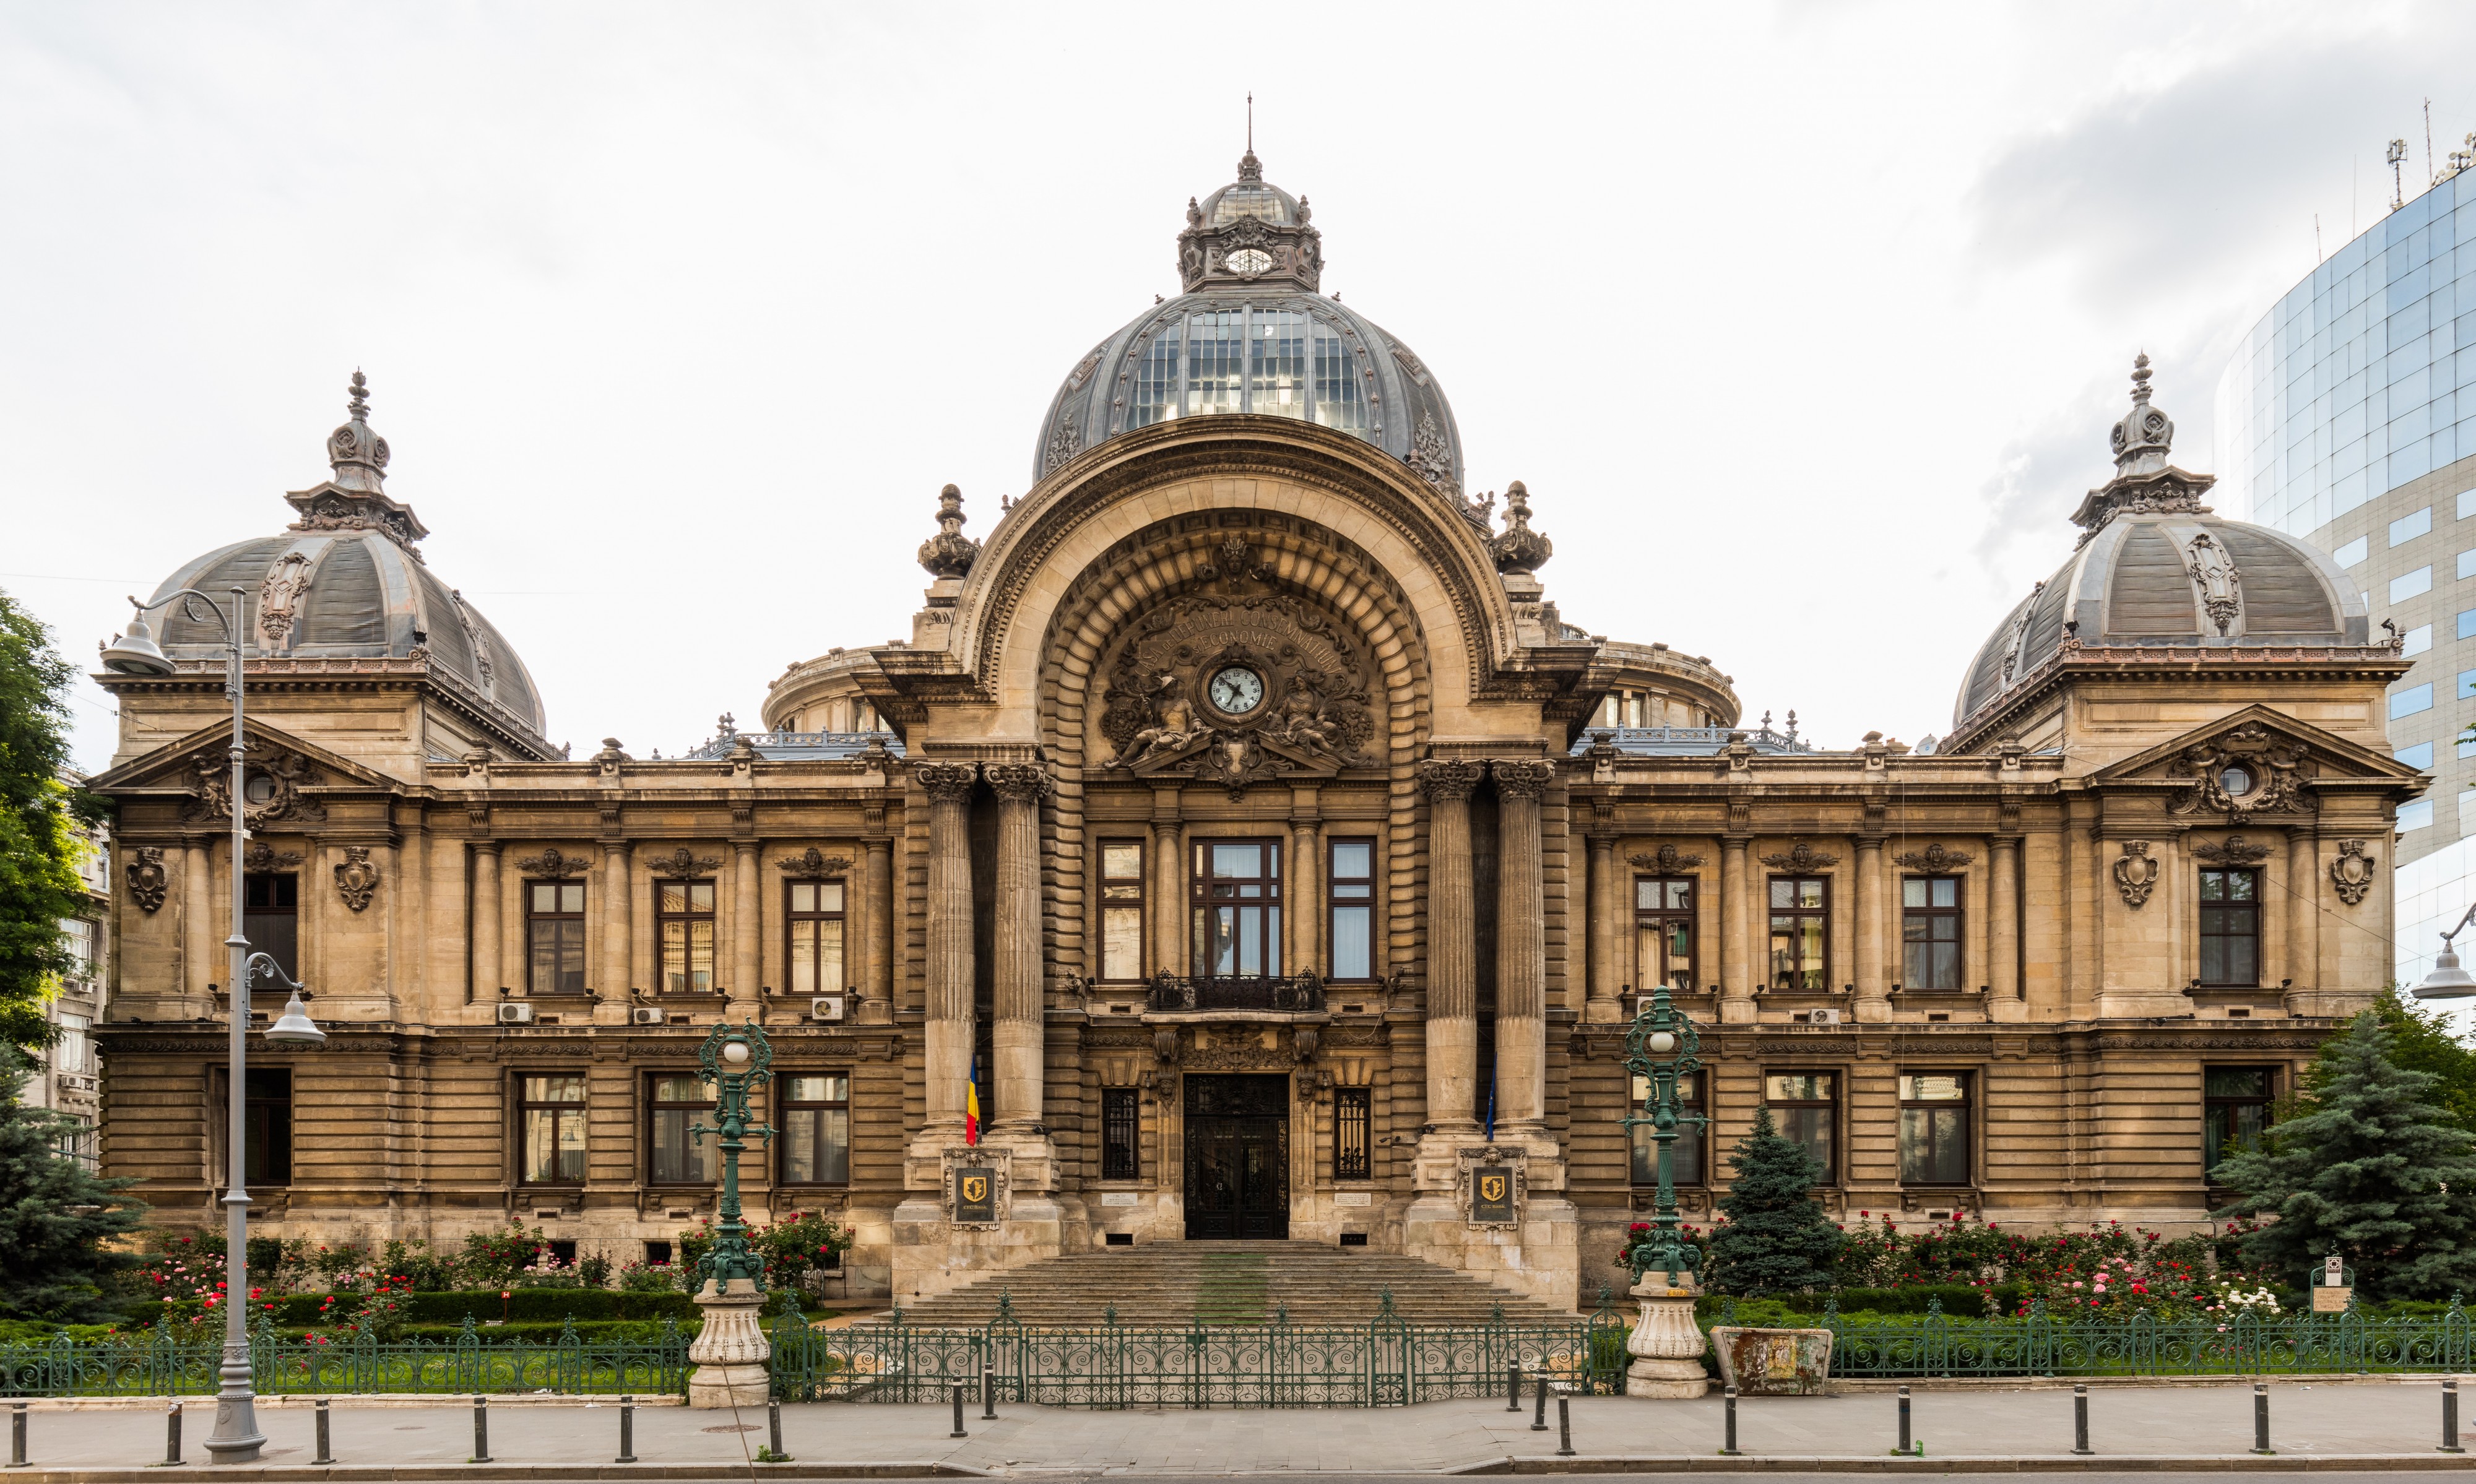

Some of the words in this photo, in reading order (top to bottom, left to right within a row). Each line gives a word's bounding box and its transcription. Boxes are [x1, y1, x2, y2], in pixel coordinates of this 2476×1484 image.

[1135, 647, 1165, 677] CASA
[1161, 639, 1175, 651] DE
[1168, 610, 1234, 644] DEPUNERI
[1240, 610, 1342, 675] CONSEMNATIUNI
[1199, 630, 1278, 651] ECONOMIE
